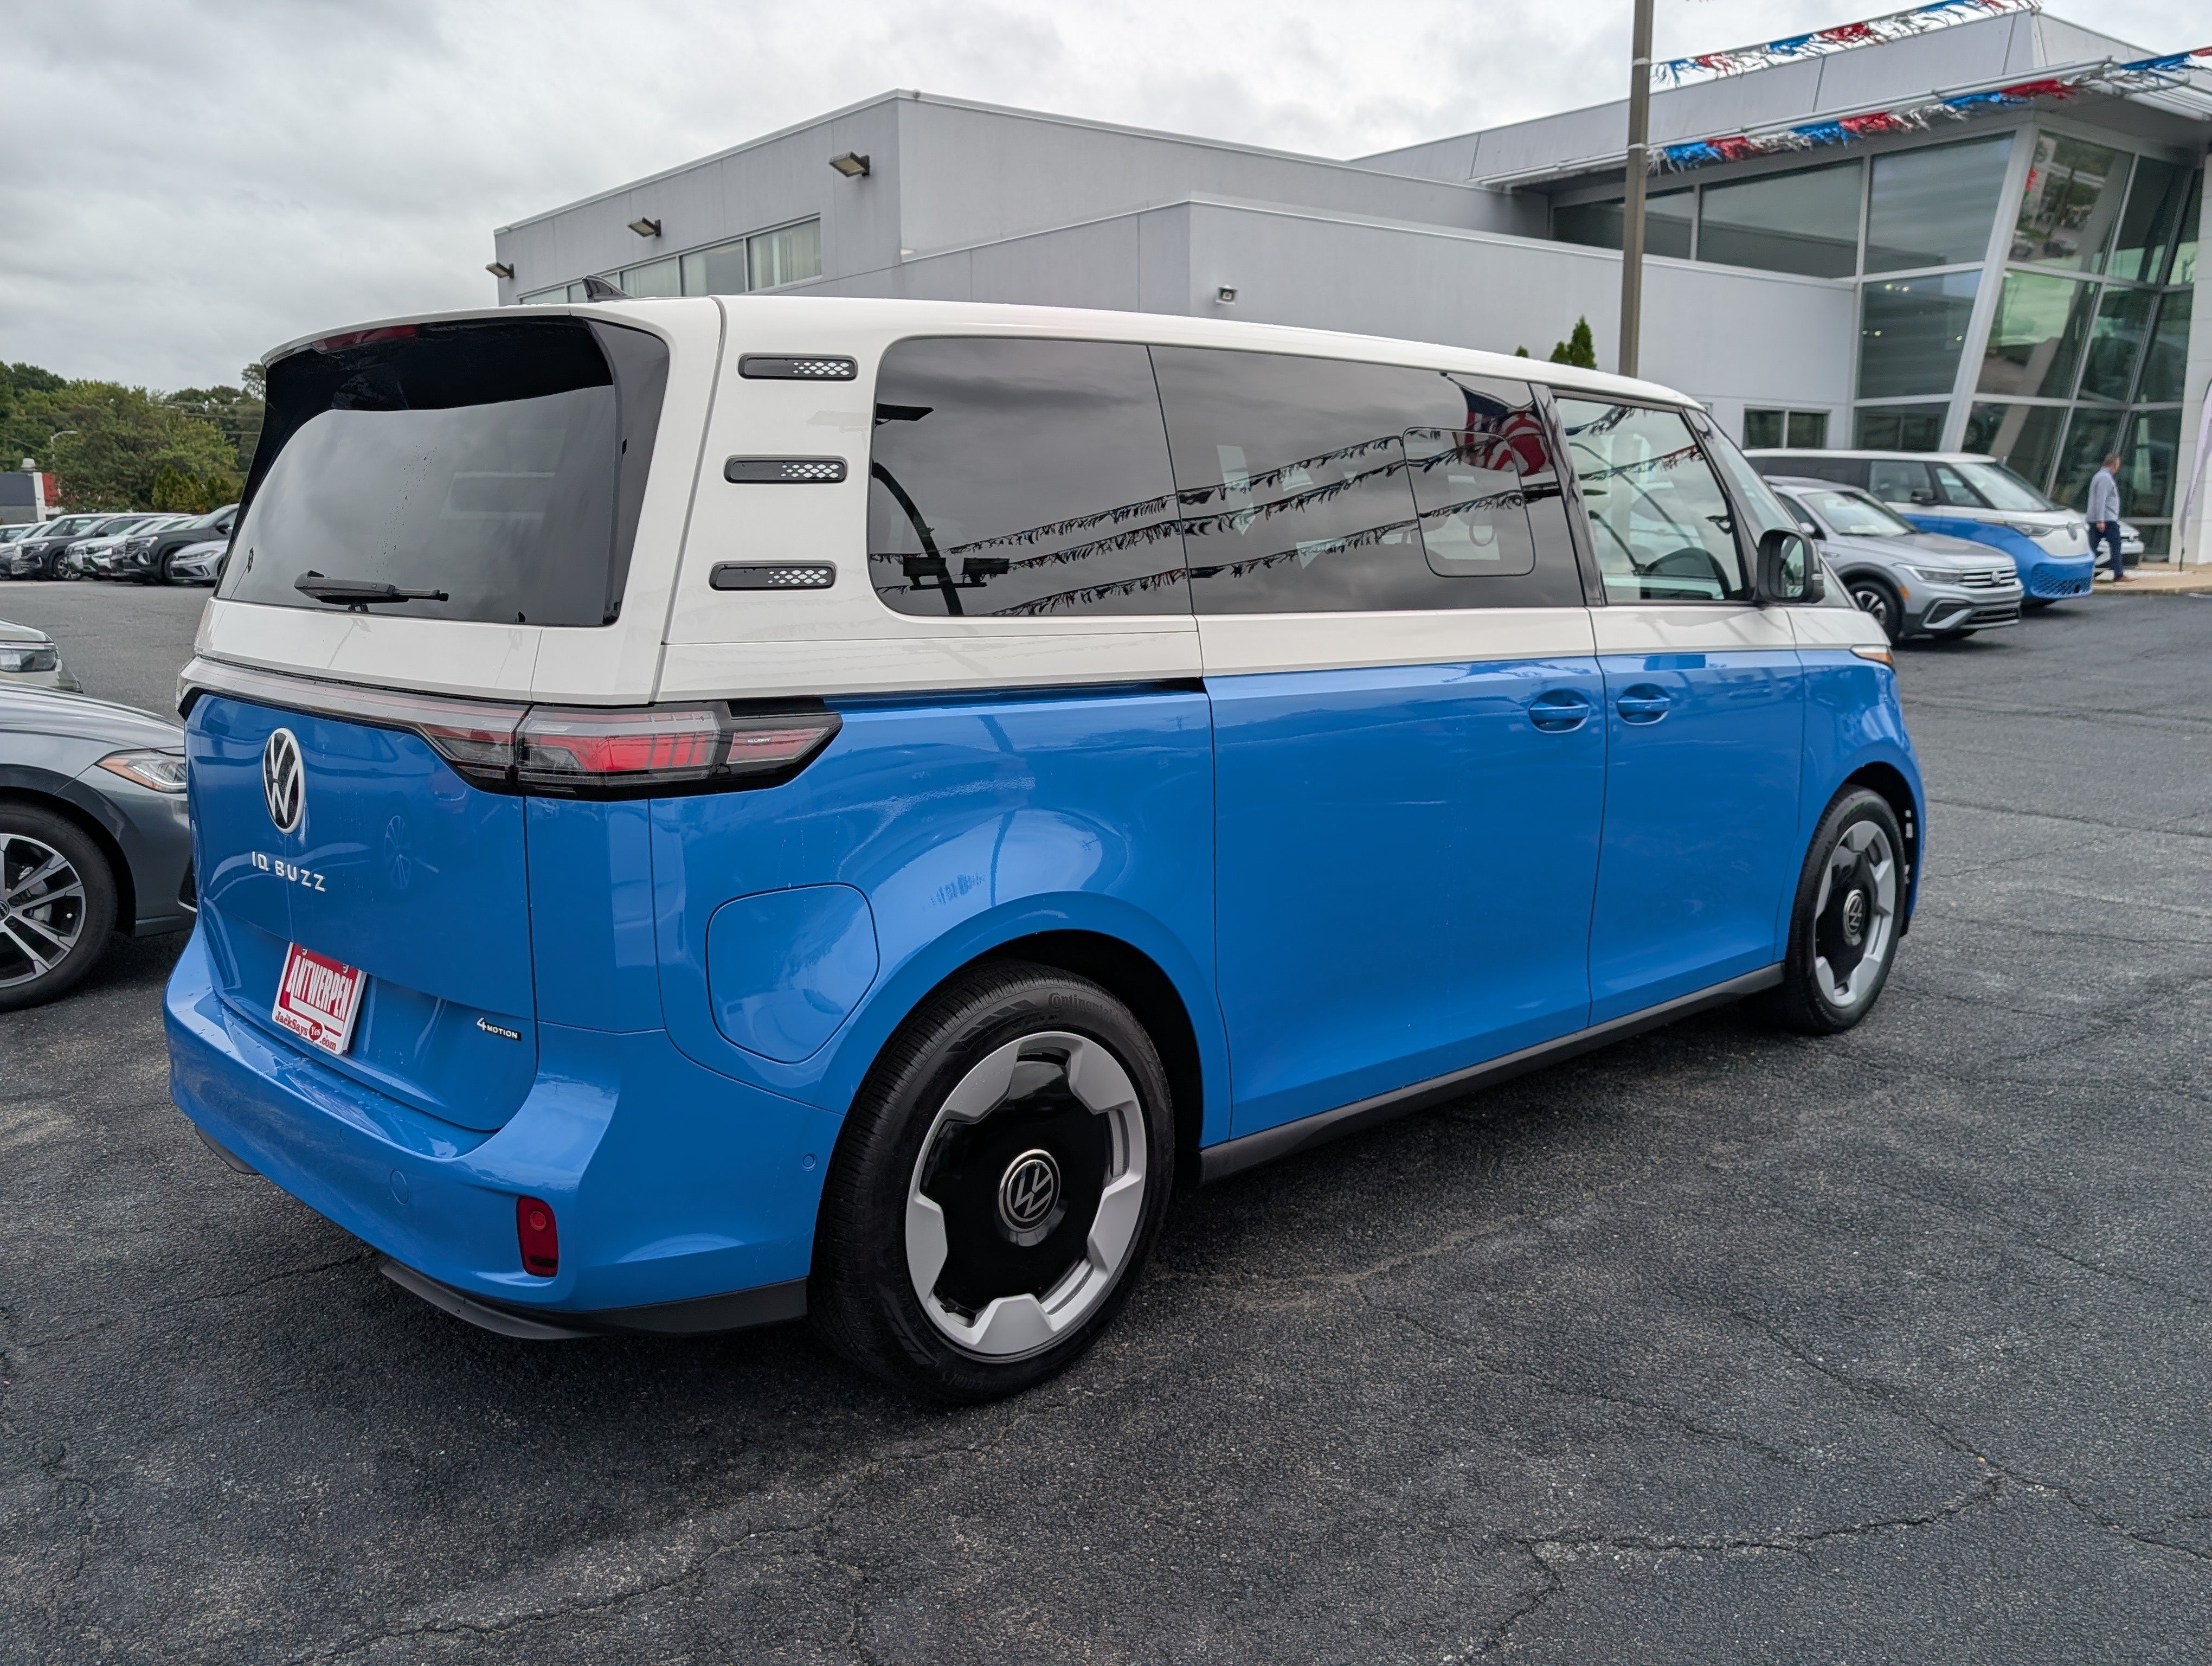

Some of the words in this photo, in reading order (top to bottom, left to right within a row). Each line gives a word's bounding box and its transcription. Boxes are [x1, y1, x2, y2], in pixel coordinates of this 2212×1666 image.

[275, 860, 326, 892] BUZZ
[285, 955, 352, 1021] ANTWERPEN
[477, 1017, 517, 1039] 4MOTION
